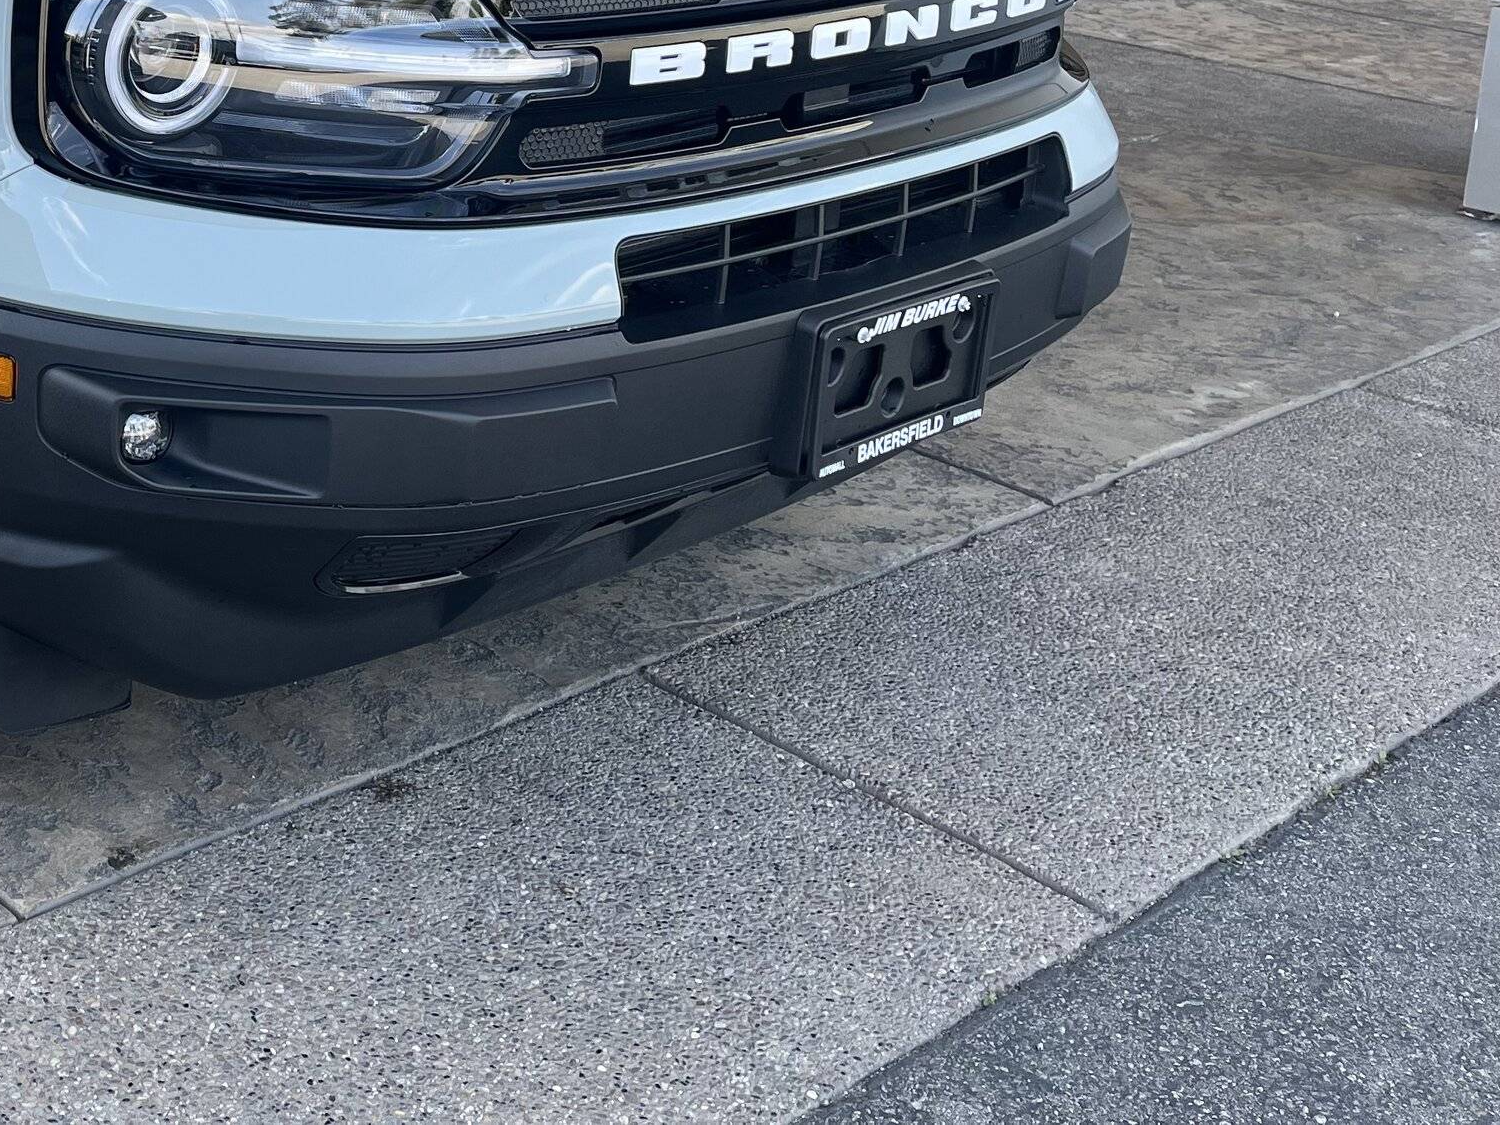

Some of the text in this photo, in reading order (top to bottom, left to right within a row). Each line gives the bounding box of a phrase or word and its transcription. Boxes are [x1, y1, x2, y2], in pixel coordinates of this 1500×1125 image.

[870, 294, 960, 336] JIM BURKE
[857, 414, 944, 463] BAKERSFIELD
